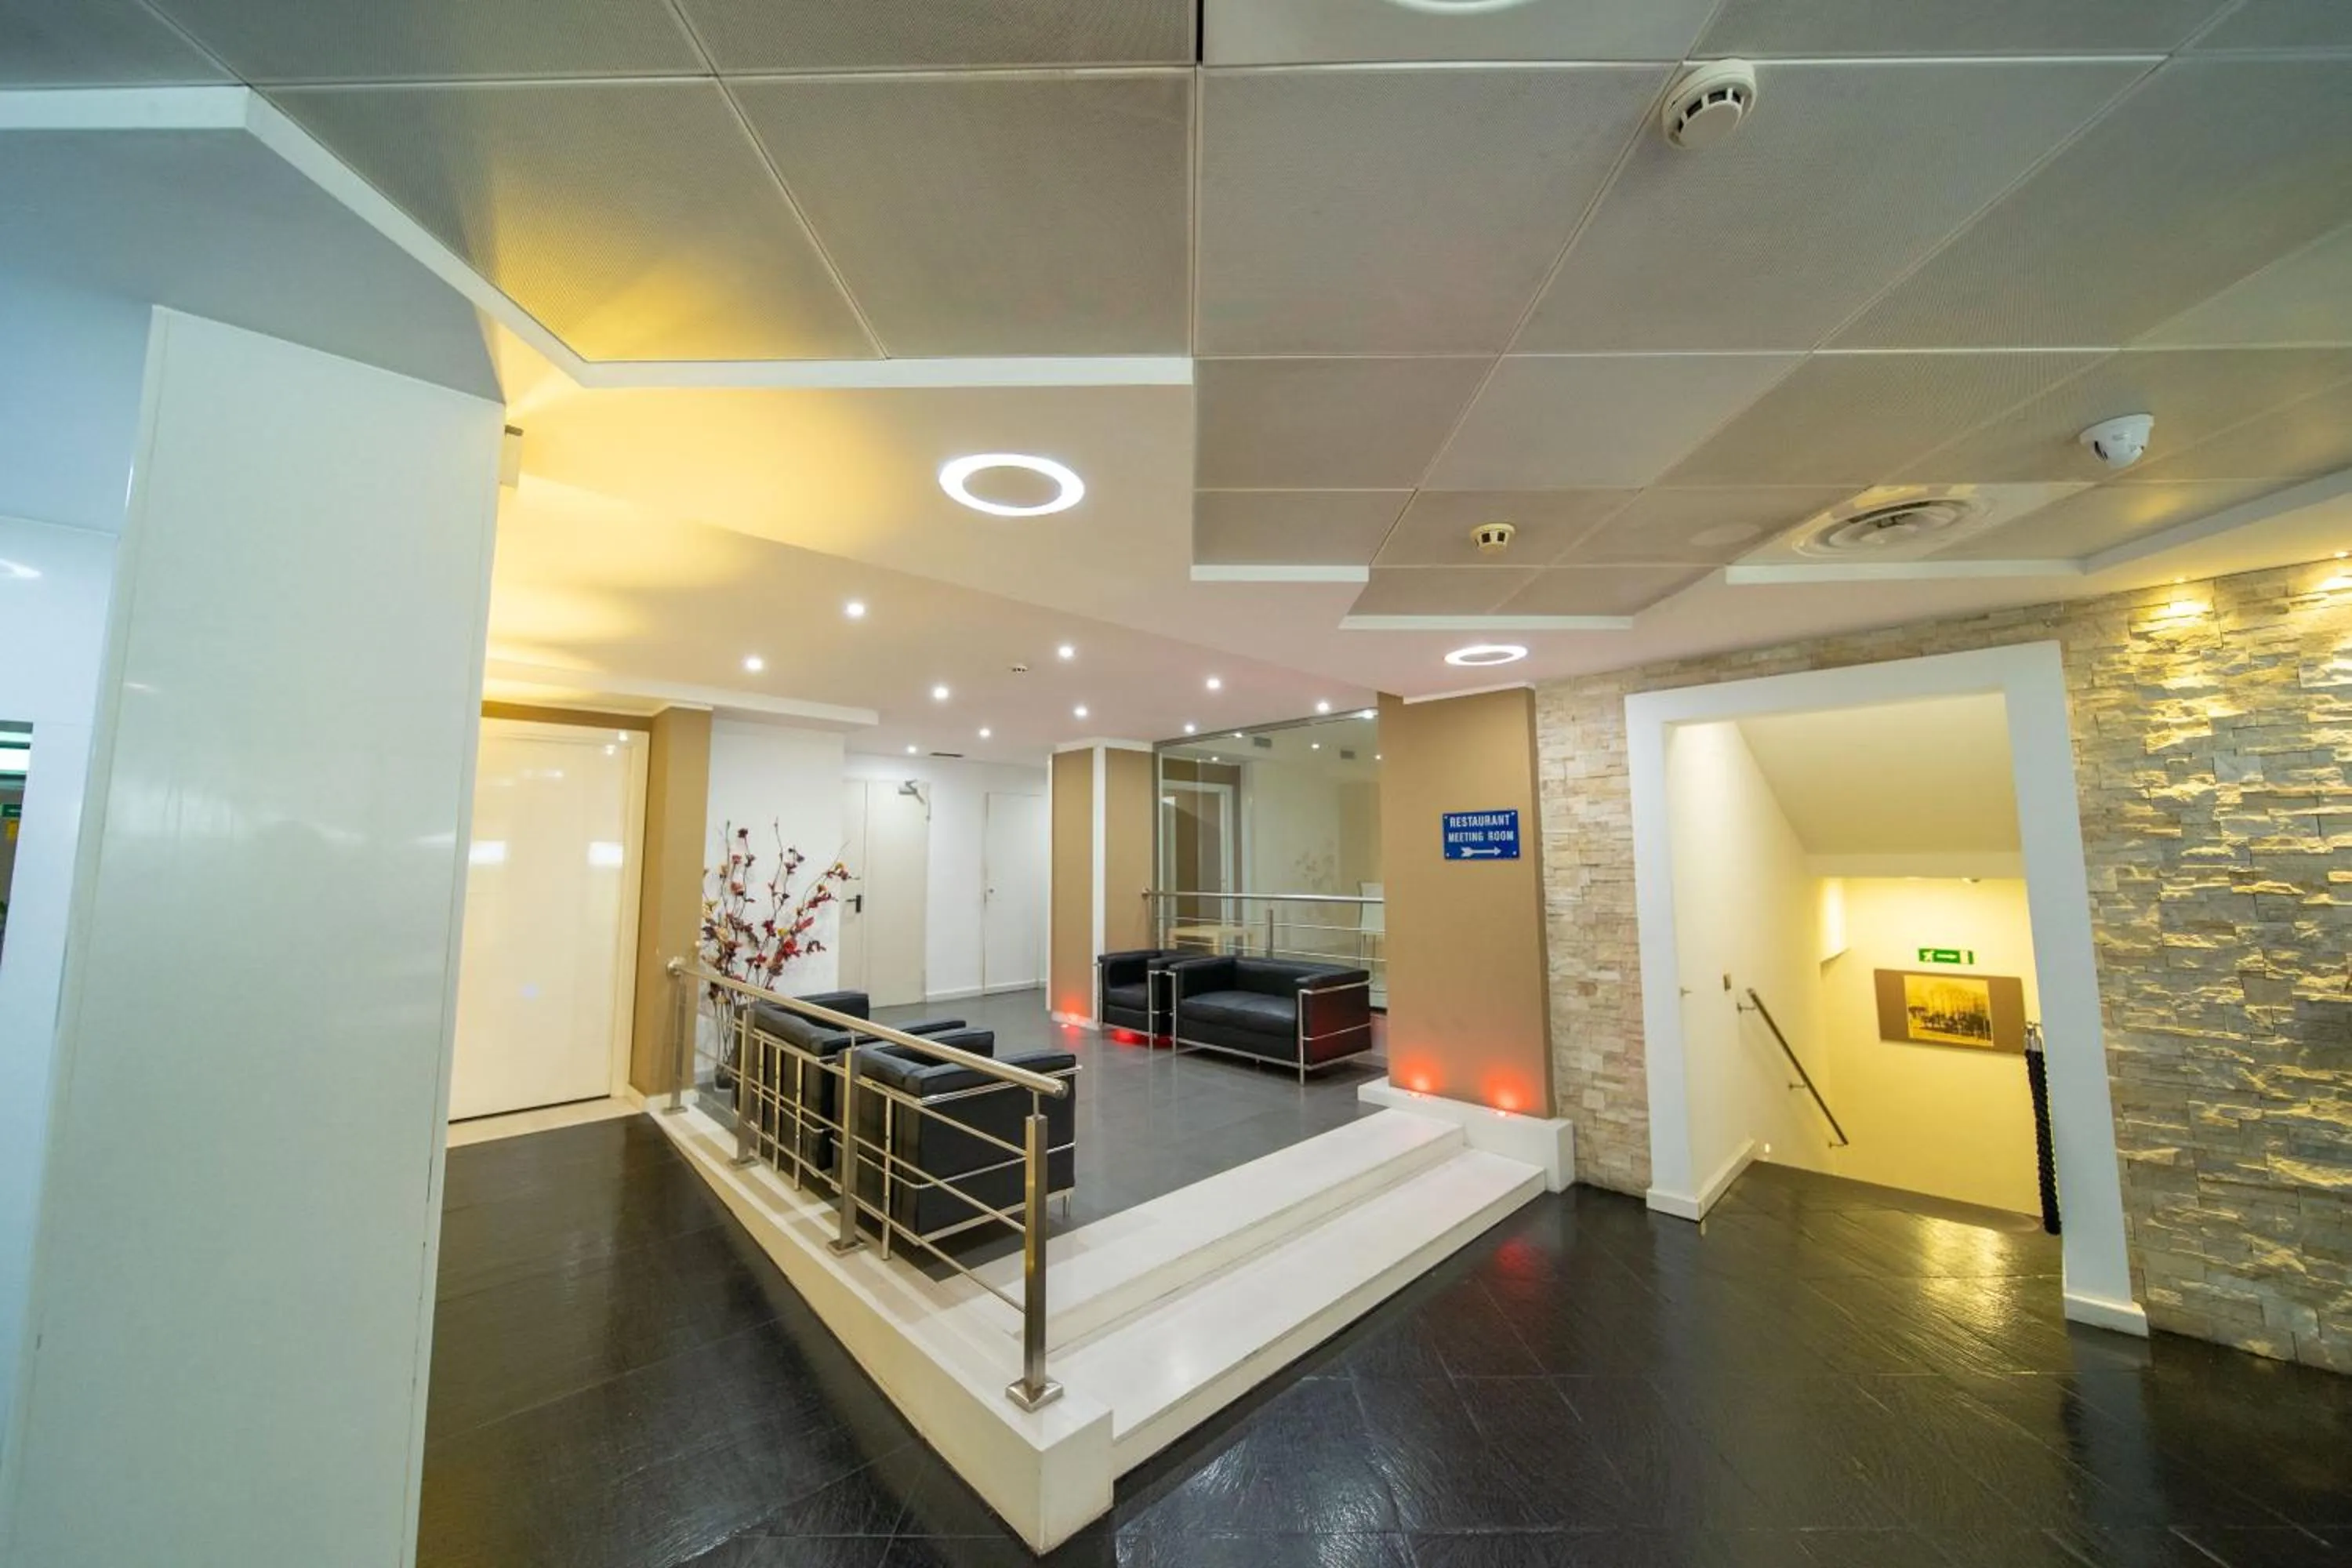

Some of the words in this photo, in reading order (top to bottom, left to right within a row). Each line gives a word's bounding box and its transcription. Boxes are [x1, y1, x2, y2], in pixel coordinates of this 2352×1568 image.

[1450, 814, 1510, 828] RESTAURANT
[1448, 831, 1484, 843] MEETING
[1487, 830, 1514, 841] ROOM
